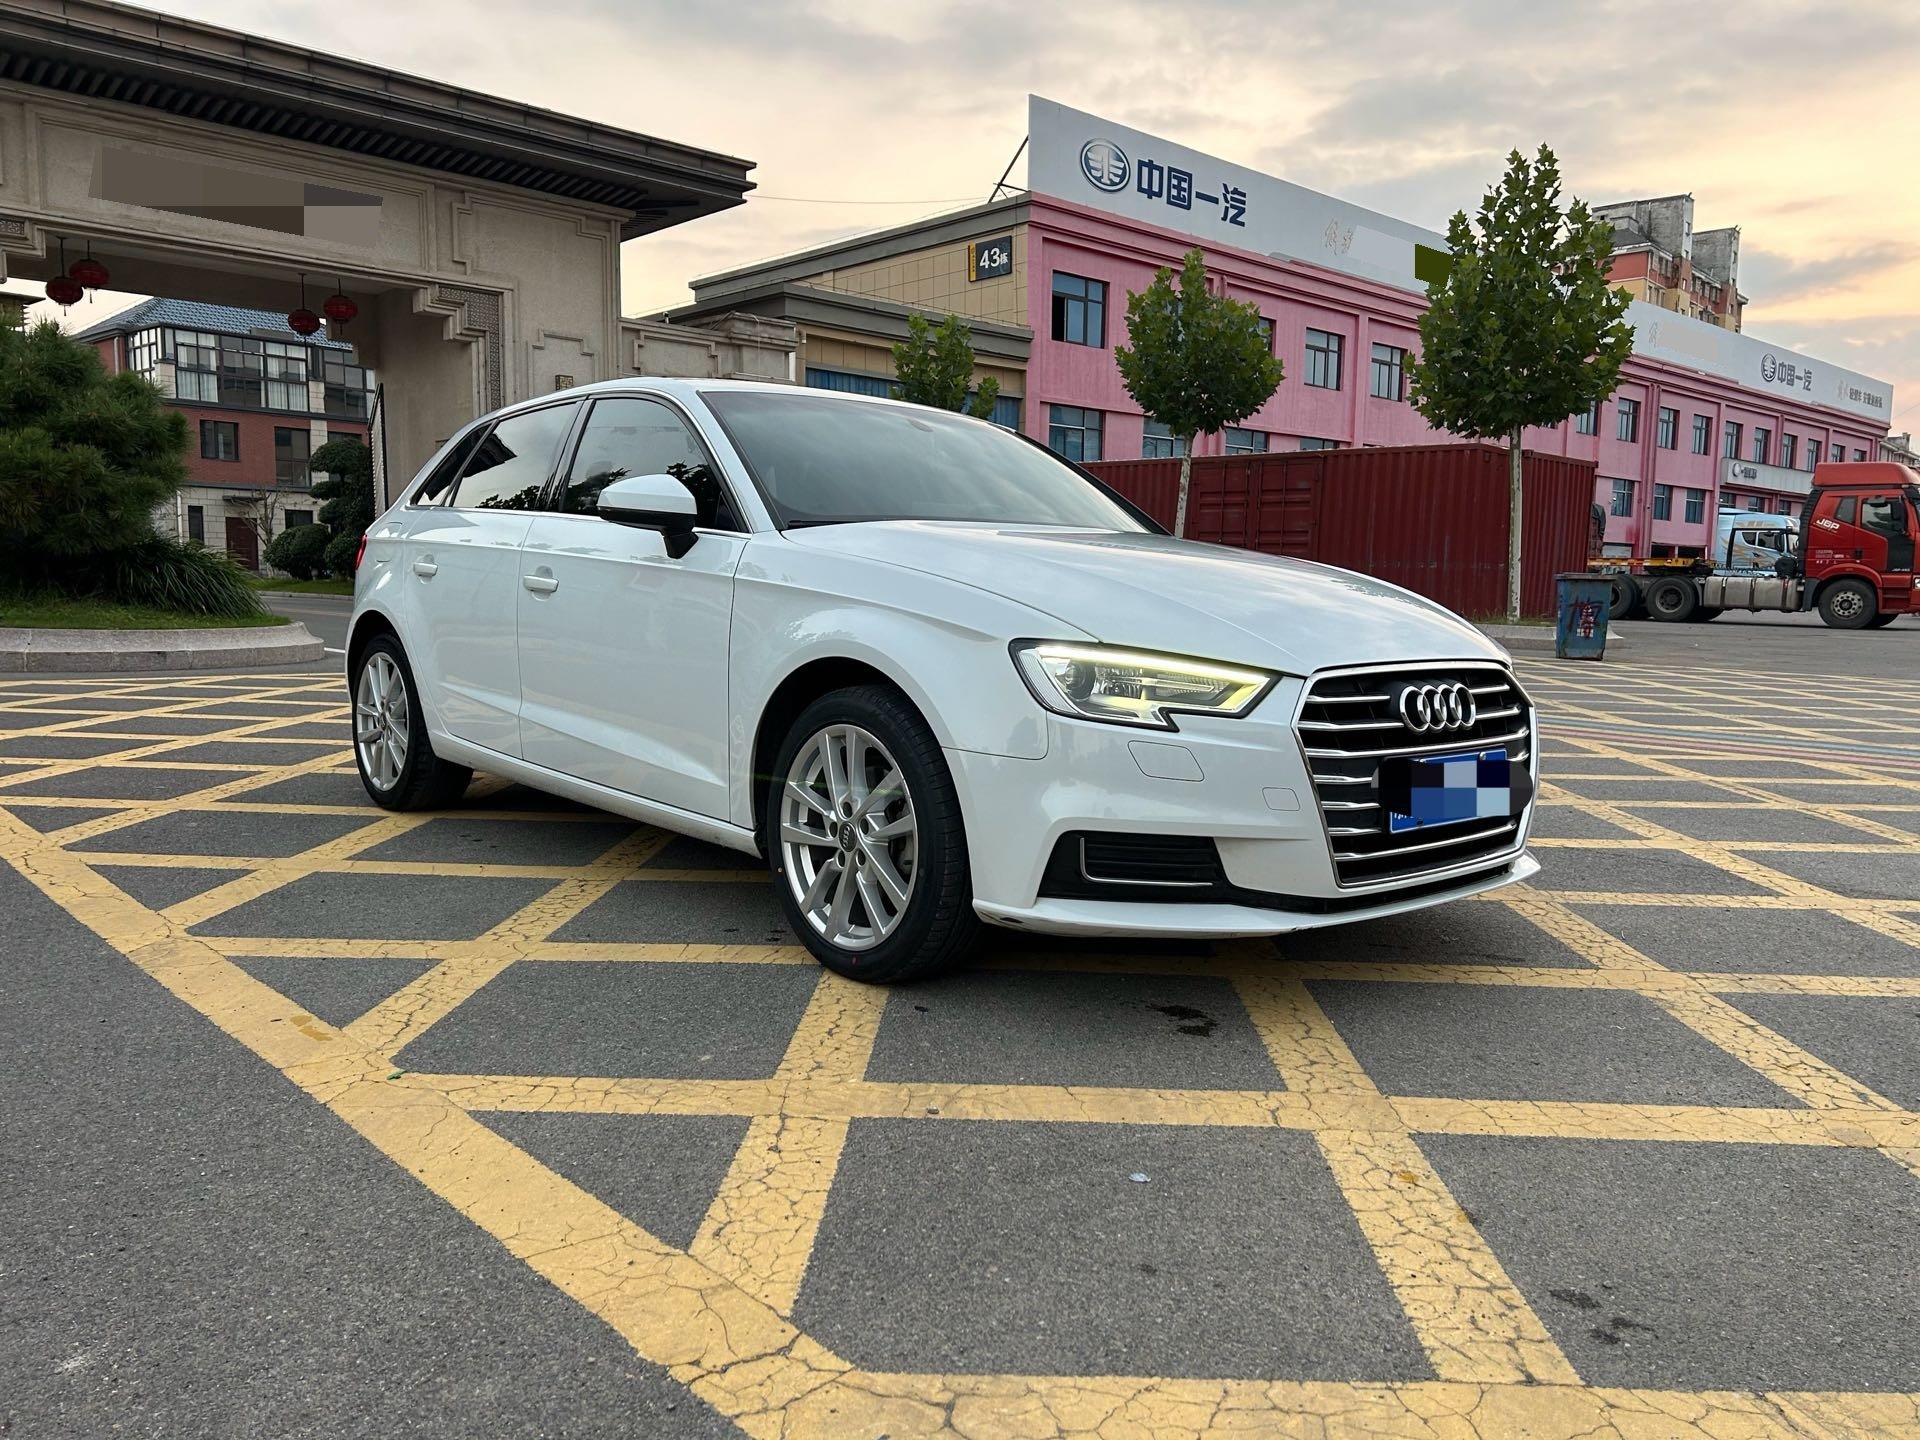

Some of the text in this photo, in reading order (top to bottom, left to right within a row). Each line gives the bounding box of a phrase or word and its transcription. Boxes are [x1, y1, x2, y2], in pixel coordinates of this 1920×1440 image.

[1136, 159, 1247, 227] 中国一汽
[1777, 361, 1813, 391] 中国一汽
